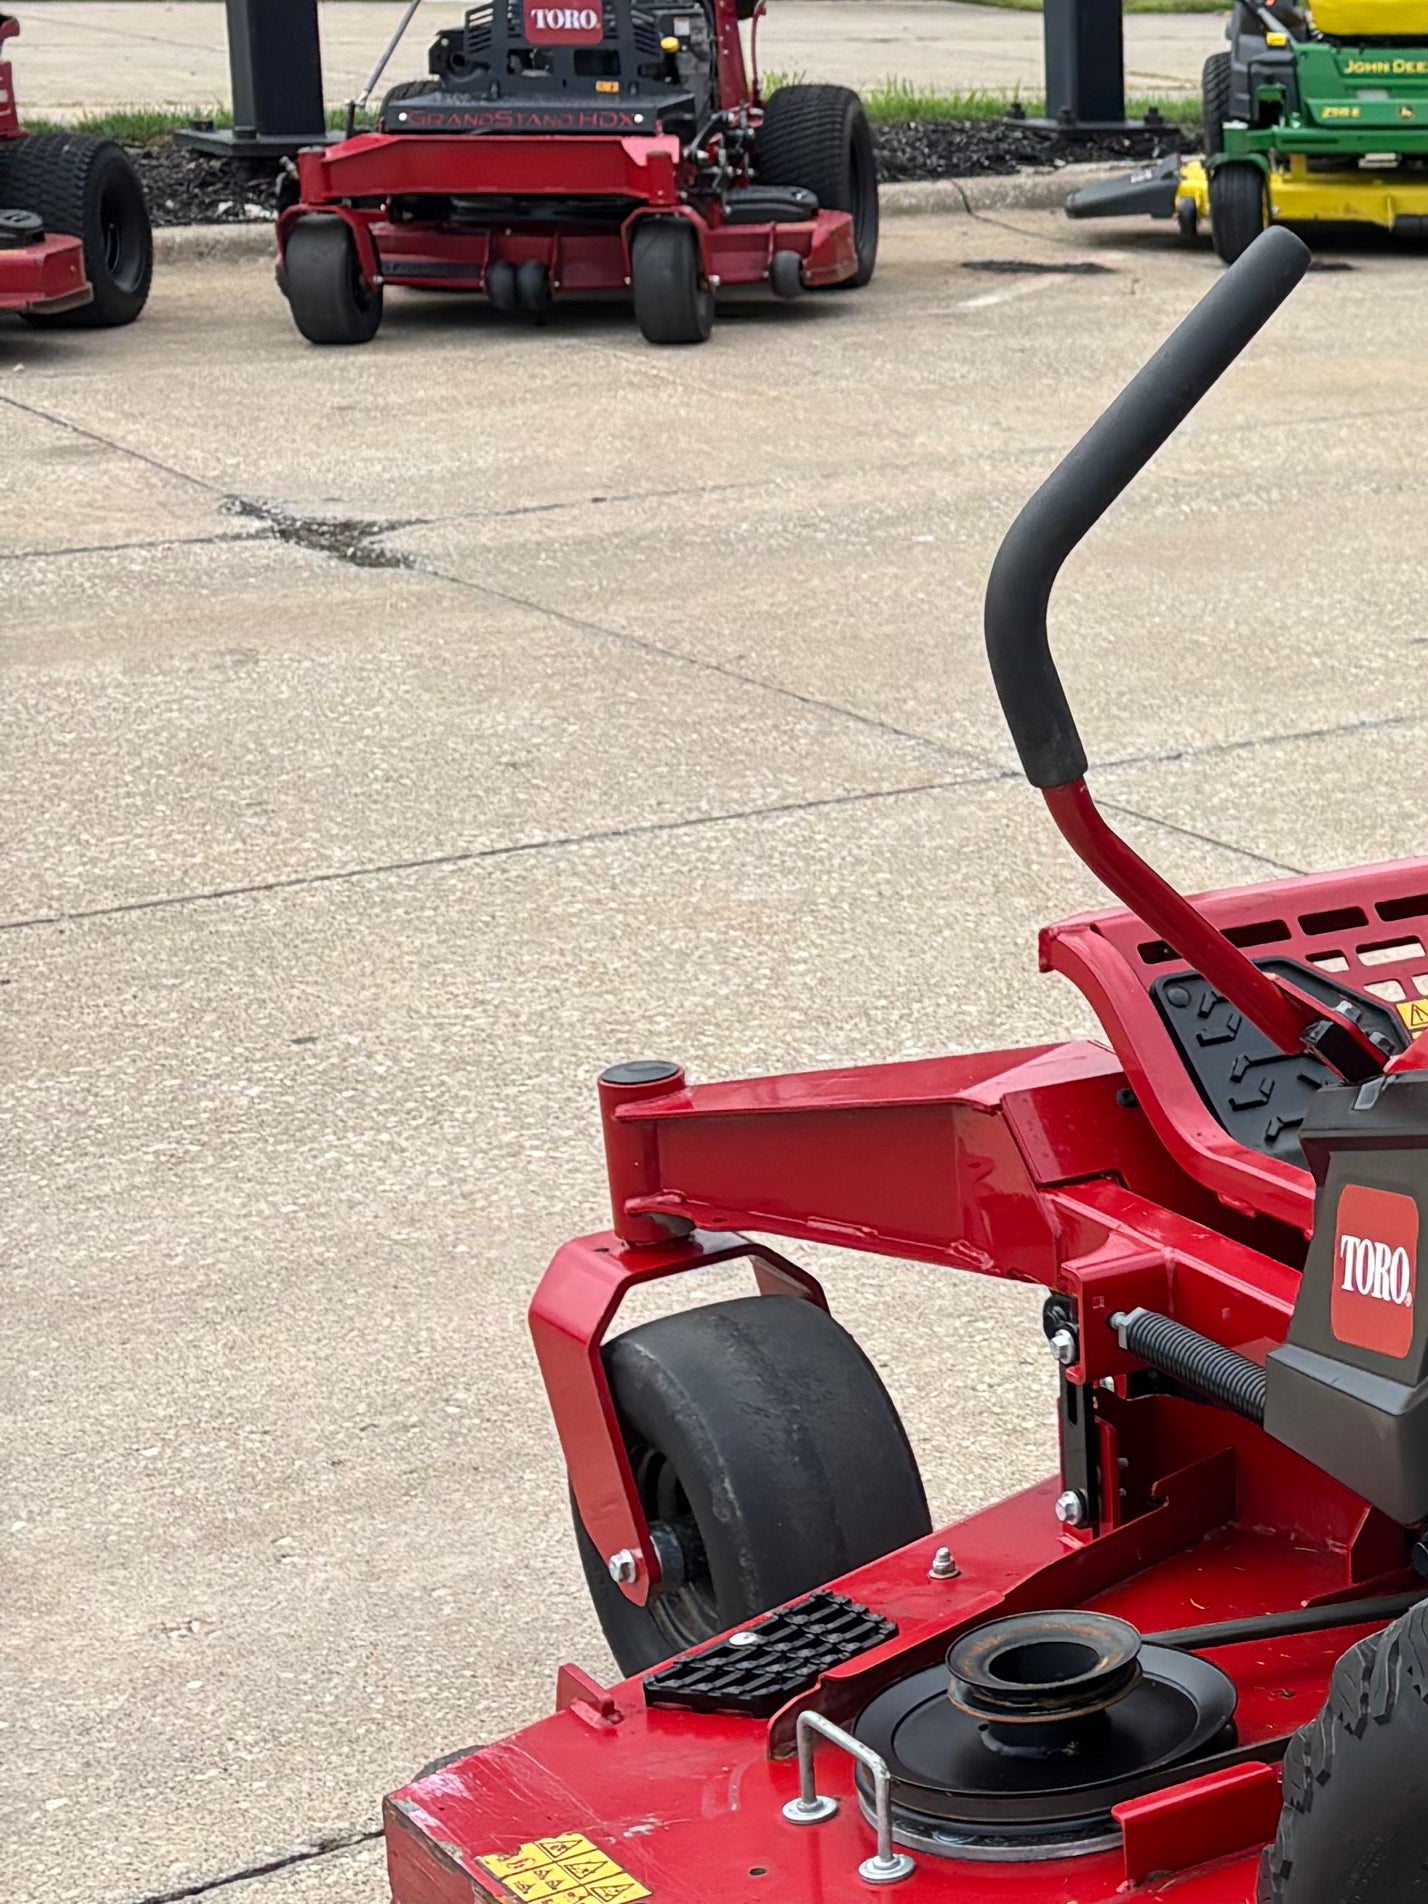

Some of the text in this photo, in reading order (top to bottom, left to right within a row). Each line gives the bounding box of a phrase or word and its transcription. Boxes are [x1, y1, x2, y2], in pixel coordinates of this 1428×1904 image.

[531, 8, 597, 30] TORO
[1343, 59, 1389, 74] JOHN
[1340, 1234, 1411, 1305] TORO
